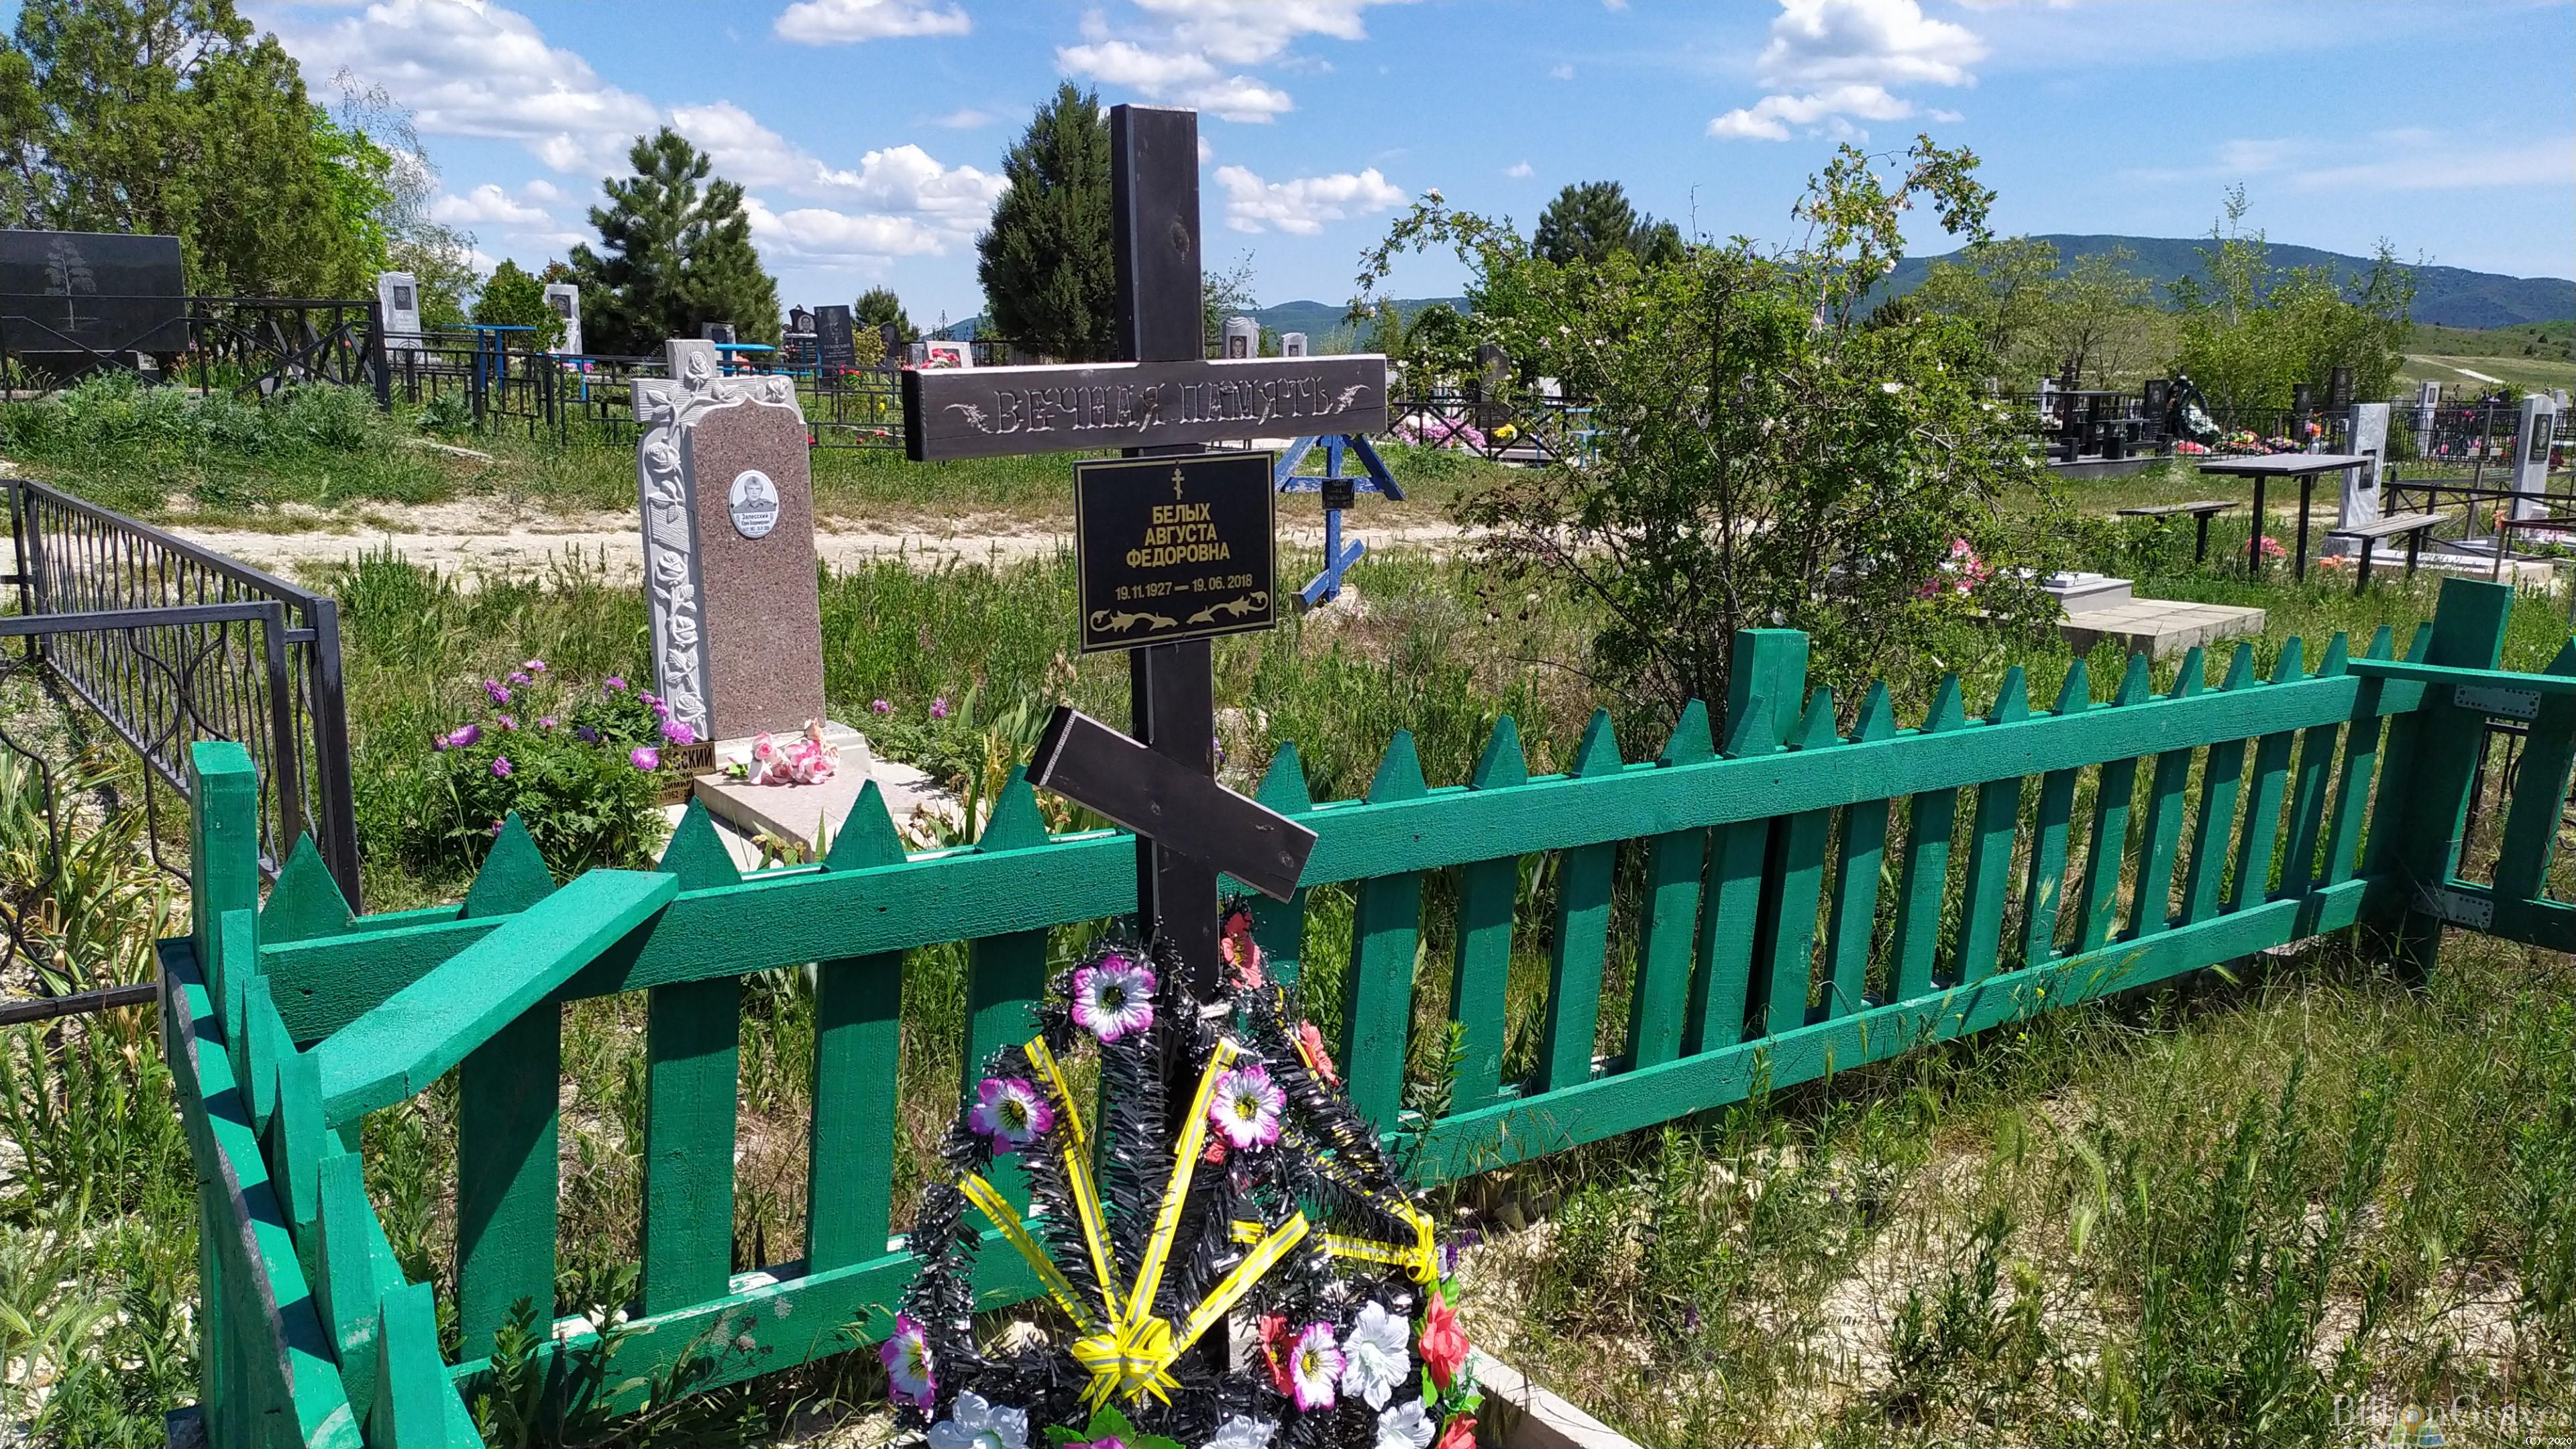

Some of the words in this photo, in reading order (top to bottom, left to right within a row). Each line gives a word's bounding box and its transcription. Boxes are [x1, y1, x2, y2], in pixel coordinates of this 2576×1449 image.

[994, 382, 1166, 434] ВЕЧНАЯ
[1177, 376, 1334, 426] ПАМЯТЬ
[1152, 503, 1212, 525] БЕЛЫХ
[1144, 523, 1218, 546] АВГУСТА
[1126, 542, 1230, 568] ФЕДОРОВНА
[1115, 582, 1173, 600] 19.11.1927
